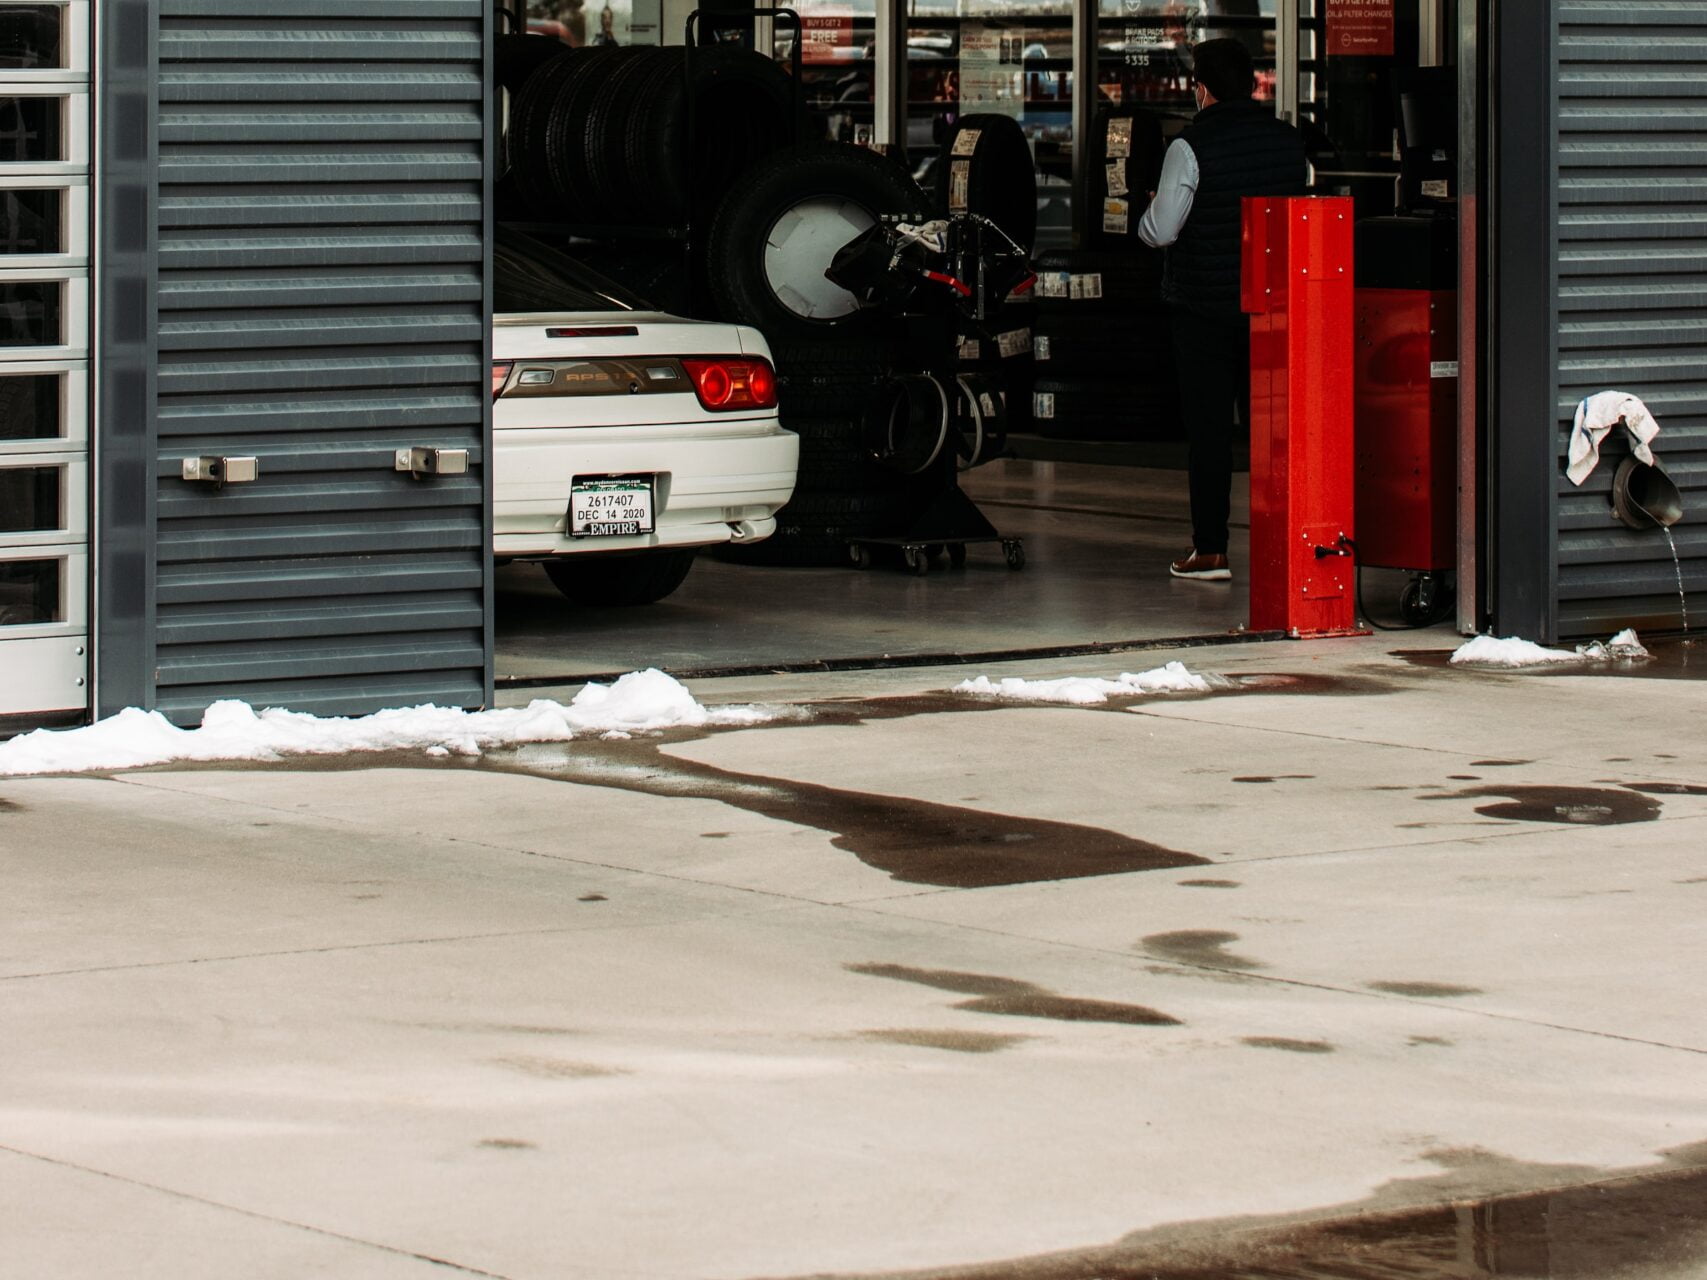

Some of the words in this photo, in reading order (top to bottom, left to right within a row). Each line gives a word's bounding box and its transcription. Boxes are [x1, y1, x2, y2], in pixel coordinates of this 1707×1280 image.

[1327, 10, 1338, 18] OIL
[1343, 10, 1363, 18] FILTER
[1363, 10, 1393, 18] CHANGES
[807, 19, 819, 27] BUY
[826, 19, 837, 27] GET
[810, 31, 838, 43] FREE
[588, 494, 634, 508] 2617407
[577, 509, 599, 520] DEC
[606, 509, 617, 519] 14
[623, 508, 645, 519] 2020
[590, 521, 637, 536] EMPIRE
